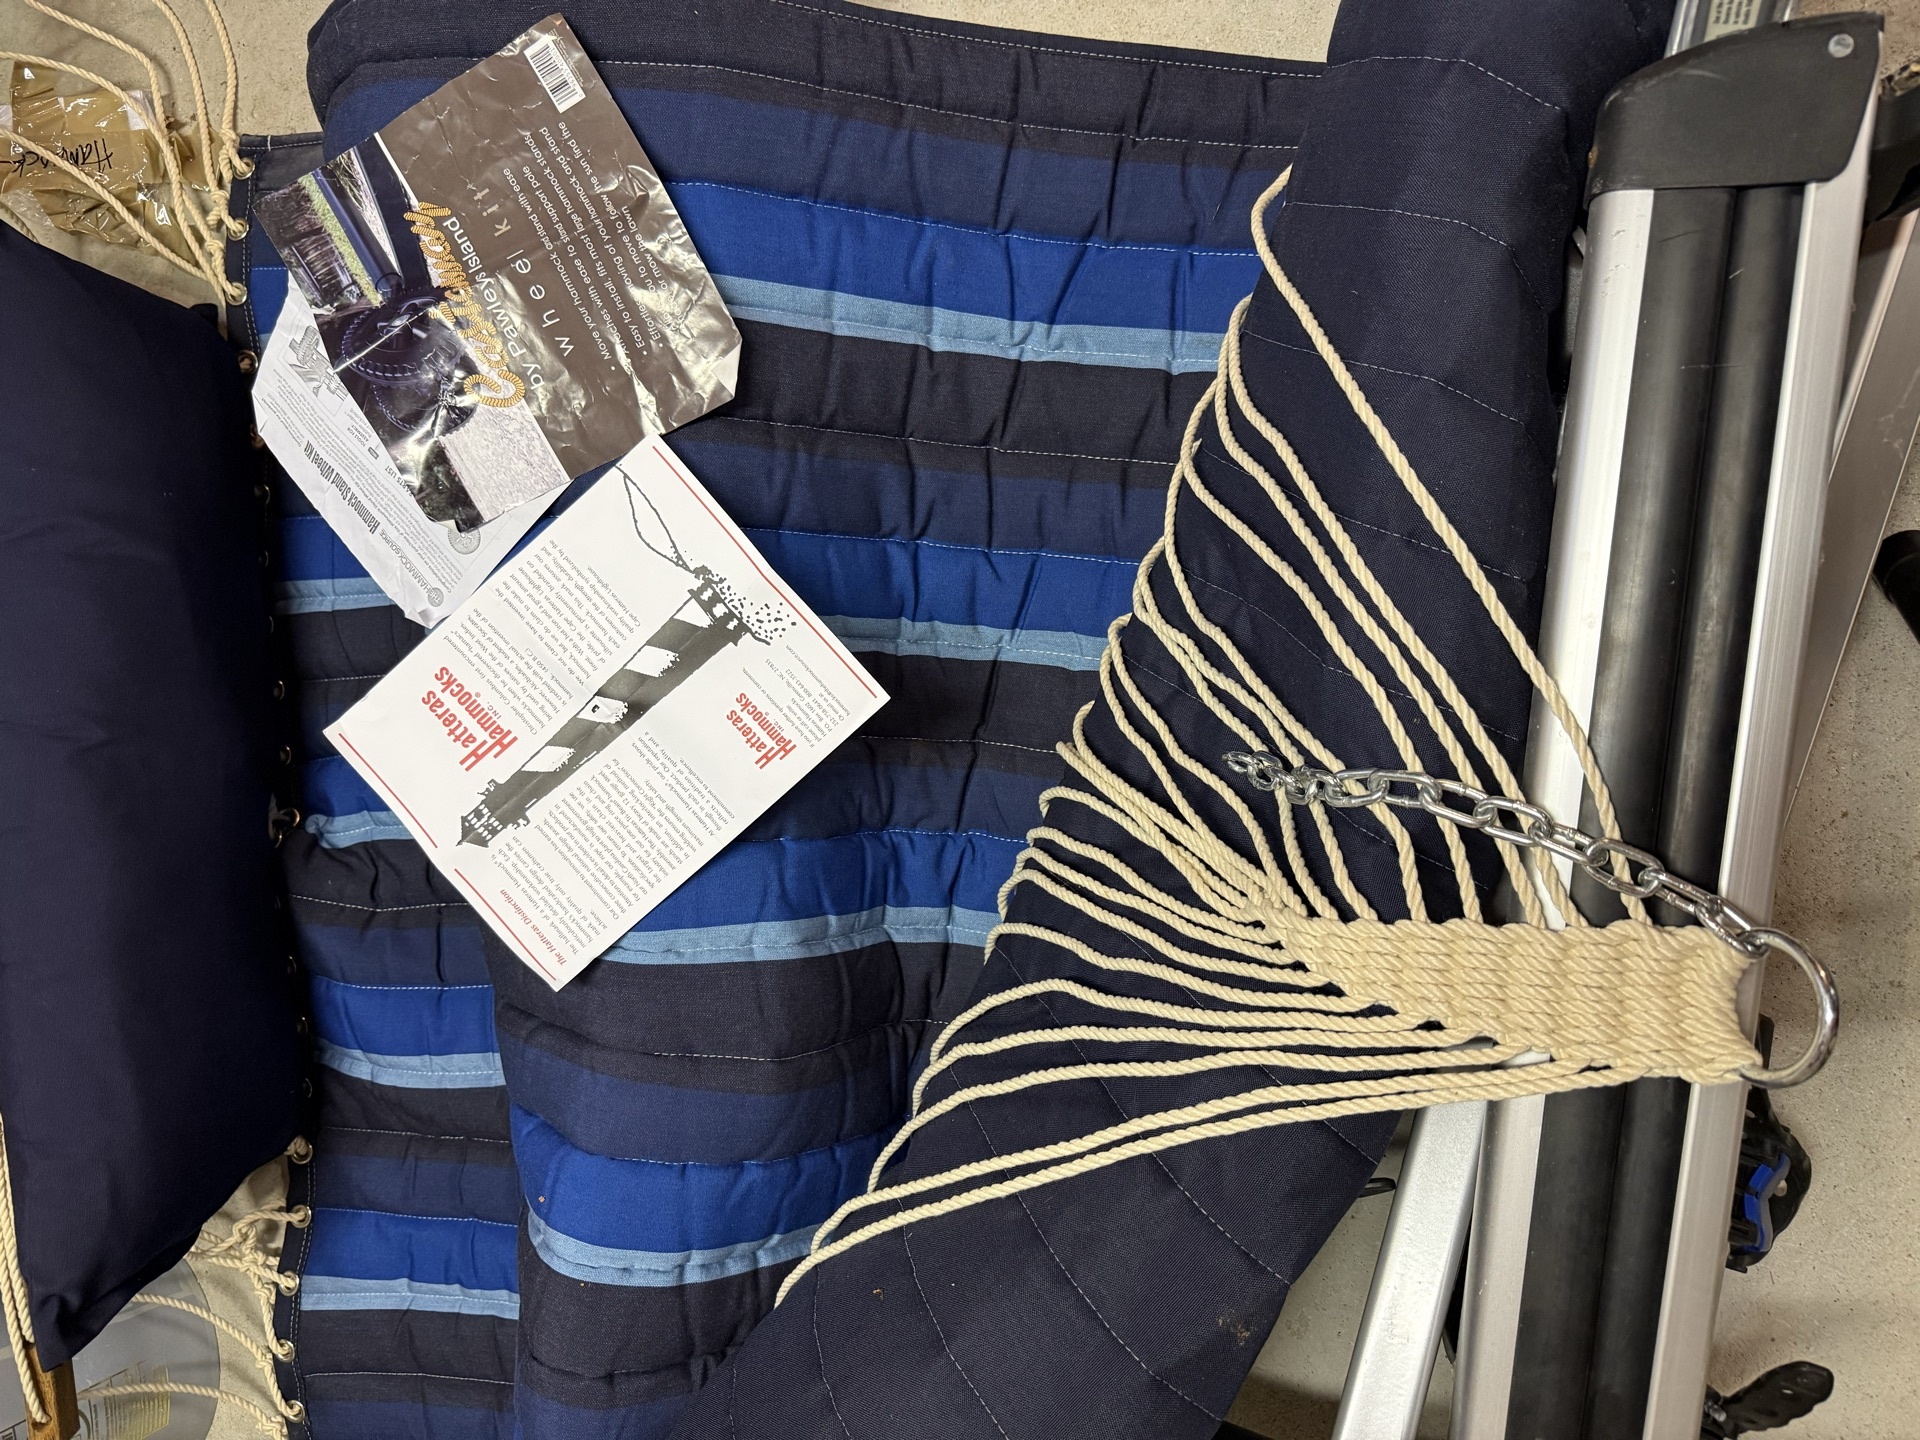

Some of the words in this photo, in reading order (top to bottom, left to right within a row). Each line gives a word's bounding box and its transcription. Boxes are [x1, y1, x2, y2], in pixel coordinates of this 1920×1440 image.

[549, 46, 564, 67] 40001
[562, 68, 576, 87] 96355
[538, 126, 560, 154] stand
[558, 121, 571, 139] the
[567, 138, 582, 158] find
[555, 155, 572, 174] and
[579, 157, 592, 175] sun
[503, 167, 520, 191] ease
[522, 165, 540, 188] pole
[588, 175, 603, 194] the
[543, 166, 574, 214] hammock
[569, 175, 598, 219] hammock
[473, 186, 512, 237] kit
[518, 192, 532, 213] with
[534, 189, 559, 222] support
[600, 194, 618, 219] follow
[528, 213, 546, 236] stand
[570, 213, 585, 232] large
[615, 221, 624, 233] to
[621, 205, 638, 232] lawn
[553, 222, 570, 243] stand
[593, 218, 611, 241] your
[441, 215, 482, 273] Island
[540, 236, 553, 250] and
[567, 244, 576, 256] to
[579, 234, 598, 259] most
[603, 243, 615, 254] of
[622, 234, 641, 264] move
[631, 232, 648, 252] the
[574, 258, 591, 283] ease
[595, 260, 607, 276] fits
[638, 265, 647, 277] to
[644, 253, 661, 277] mow
[549, 251, 582, 305] hammock
[657, 279, 669, 291] or
[506, 249, 574, 357] wheel
[588, 285, 602, 308] with
[603, 277, 625, 310] install,
[402, 202, 523, 407] Castaway
[577, 306, 596, 329] your
[622, 311, 631, 322] to
[592, 330, 611, 359] Move
[628, 325, 645, 348] Easy
[521, 363, 545, 390] by
[303, 439, 315, 459] Kit
[310, 450, 335, 482] Wheel
[384, 464, 397, 478] LIST
[329, 471, 351, 501] Stand
[347, 491, 380, 534] Hammock
[494, 587, 504, 597] the
[502, 580, 511, 590] the
[510, 589, 524, 604] make
[472, 607, 482, 617] the
[502, 597, 525, 620] invented
[529, 610, 543, 625] claim
[460, 621, 475, 639] Indies.
[467, 614, 487, 637] Socrates,
[487, 622, 510, 646] invention
[525, 620, 537, 635] have
[443, 635, 475, 667] encountered
[474, 638, 488, 653] West
[488, 651, 497, 661] the
[492, 641, 510, 660] student
[508, 645, 525, 660] actual
[543, 641, 558, 656] claim
[558, 642, 568, 653] but
[473, 652, 500, 679] discovered
[523, 660, 533, 670] the
[536, 660, 548, 672] (450
[557, 656, 567, 666] not
[568, 651, 591, 679] hammock,
[474, 667, 486, 679] first
[503, 667, 520, 685] natives
[532, 668, 543, 681] with
[485, 678, 510, 705] Columbus
[507, 686, 521, 701] when
[541, 680, 562, 700] credited
[550, 672, 573, 699] hammock.
[525, 692, 539, 705] used
[538, 689, 560, 714] However,
[433, 666, 518, 759] Hammocks
[486, 701, 501, 720] INC.
[509, 705, 537, 735] Christopher
[520, 701, 545, 729] hammocks
[538, 704, 552, 721] being
[420, 690, 493, 772] Hatteras
[735, 692, 797, 760] Hammocks
[631, 742, 646, 758] shows
[725, 709, 779, 770] Hatteras
[644, 757, 659, 771] pride
[655, 770, 665, 780] our
[691, 809, 709, 830] Hatteras
[498, 847, 510, 862] Each
[499, 889, 532, 925] Distinction
[520, 887, 540, 909] Hatteras
[538, 895, 559, 916] detailed
[530, 924, 556, 952] Hatteras
[549, 920, 570, 944] hallmark
[557, 916, 586, 948] meticulously
[554, 951, 566, 965] The
[569, 943, 578, 955] The
